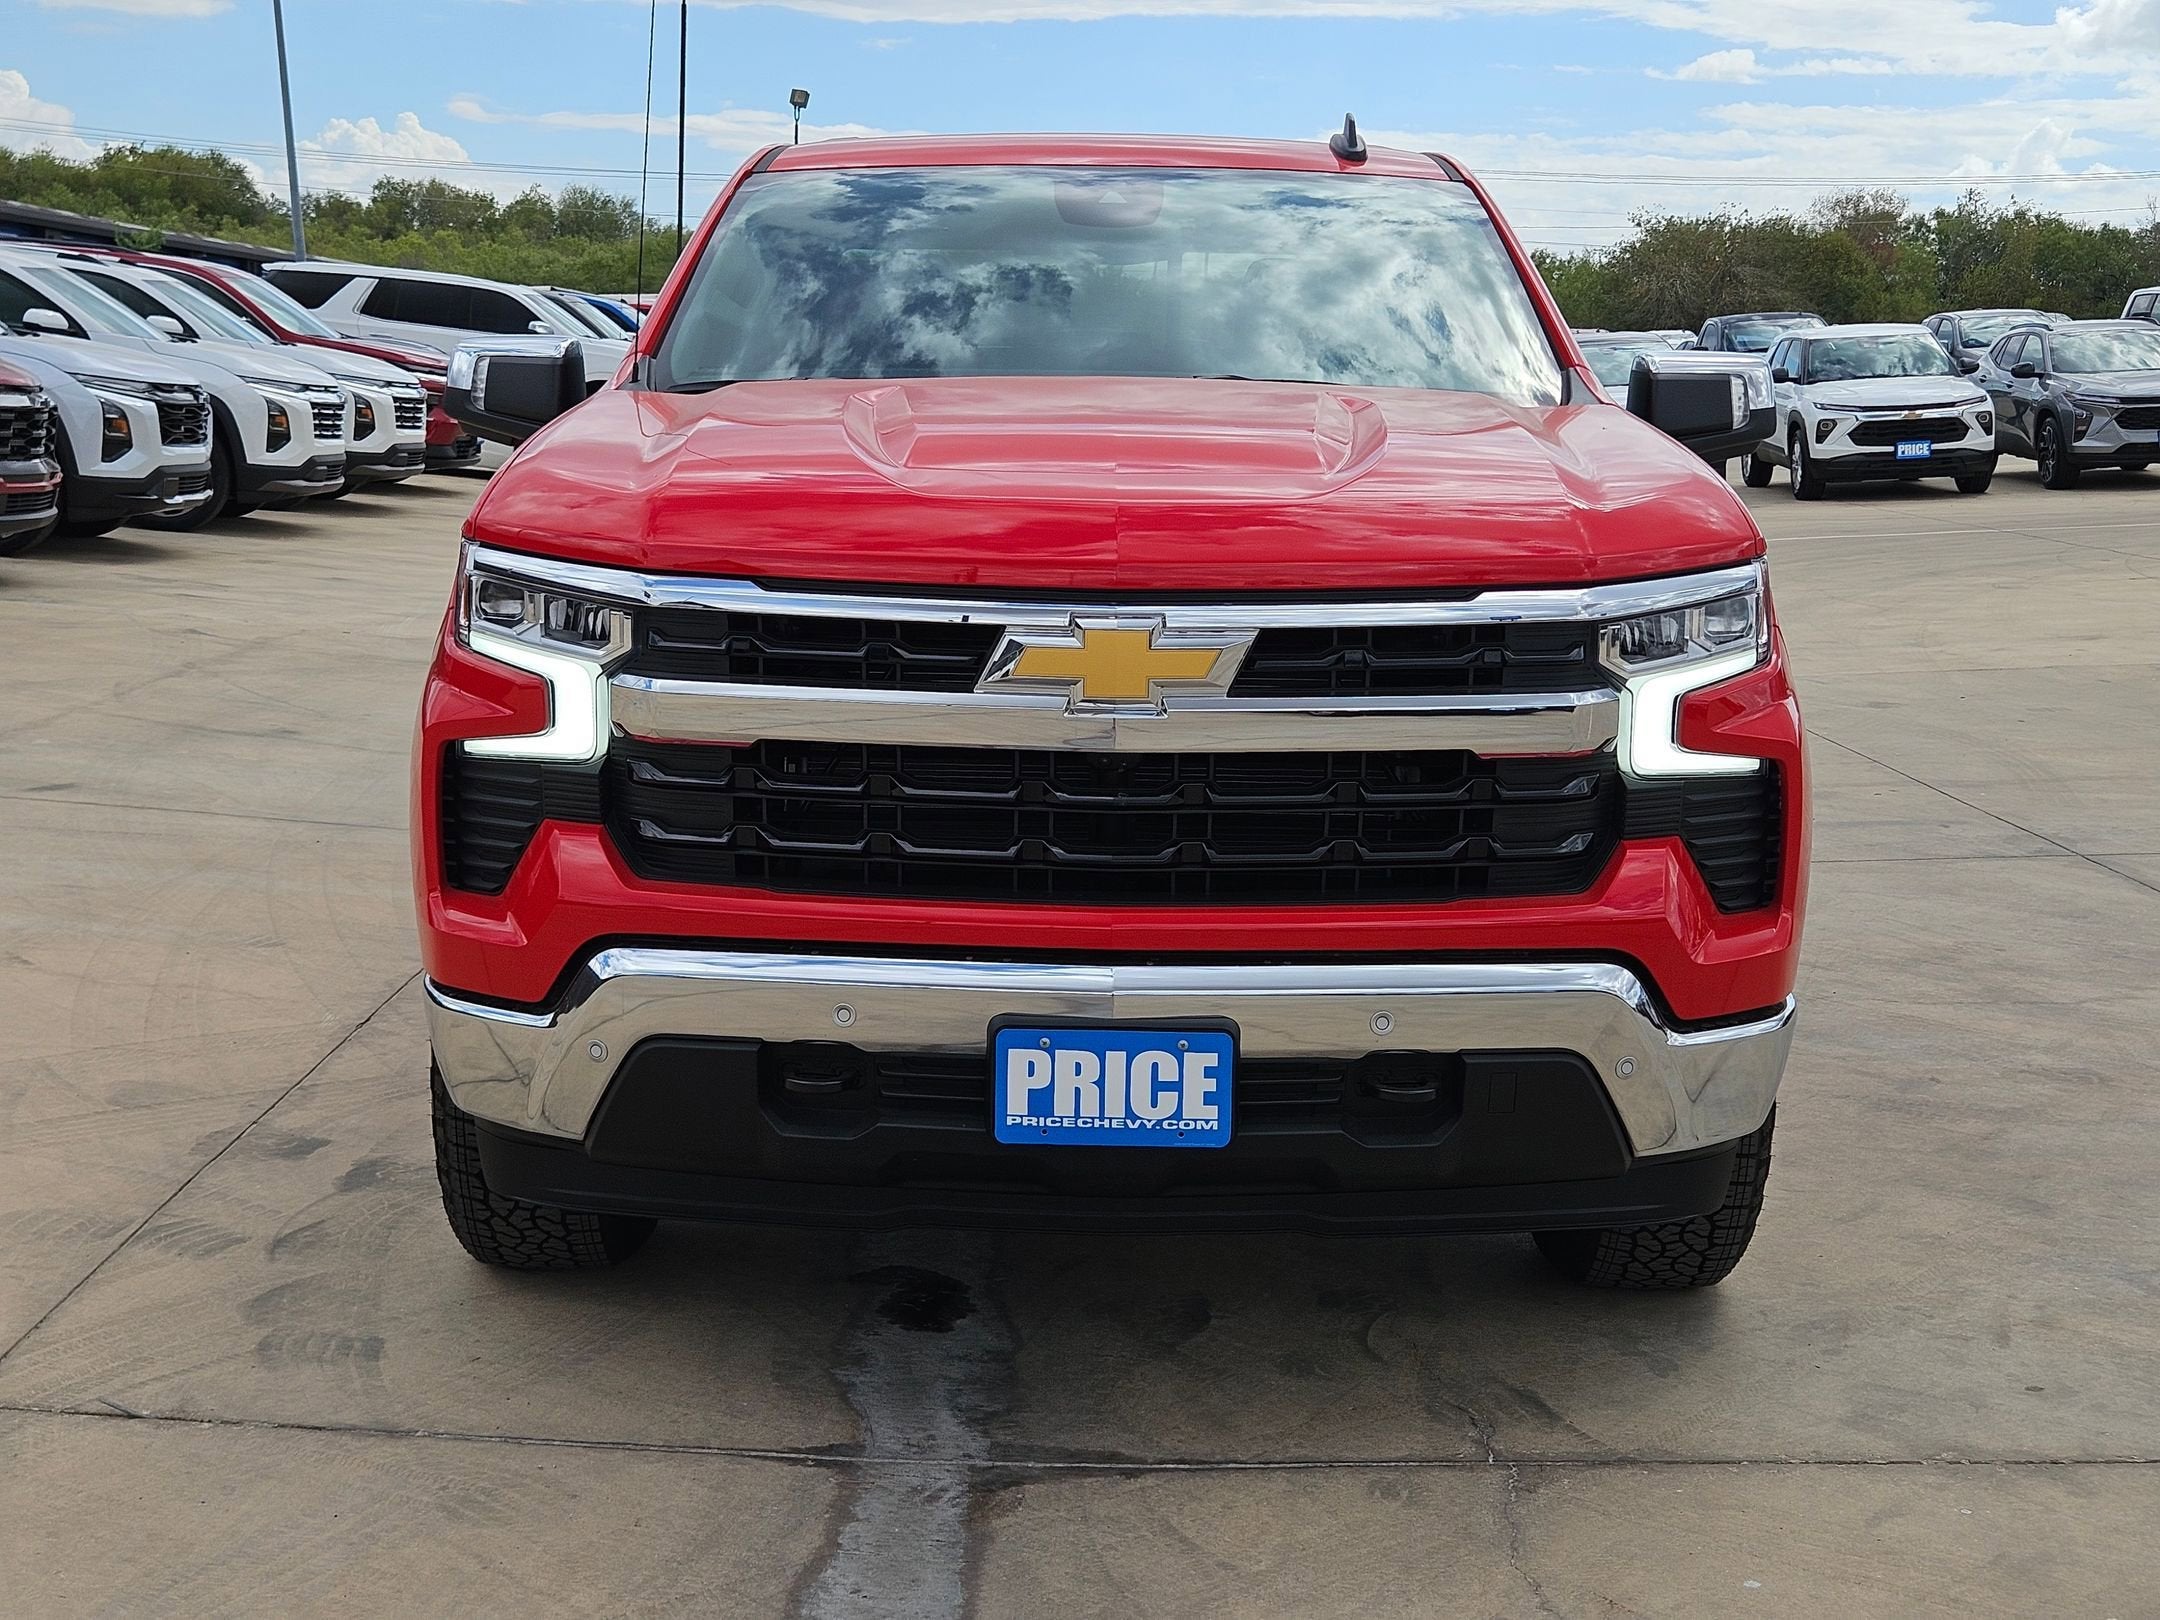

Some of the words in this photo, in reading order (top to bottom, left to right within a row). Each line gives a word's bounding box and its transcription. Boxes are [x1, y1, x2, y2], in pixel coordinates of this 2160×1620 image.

[1898, 443, 1930, 456] PRICE
[1007, 1049, 1218, 1120] PRICE
[1006, 1116, 1218, 1130] PRICECHEVY.COM
